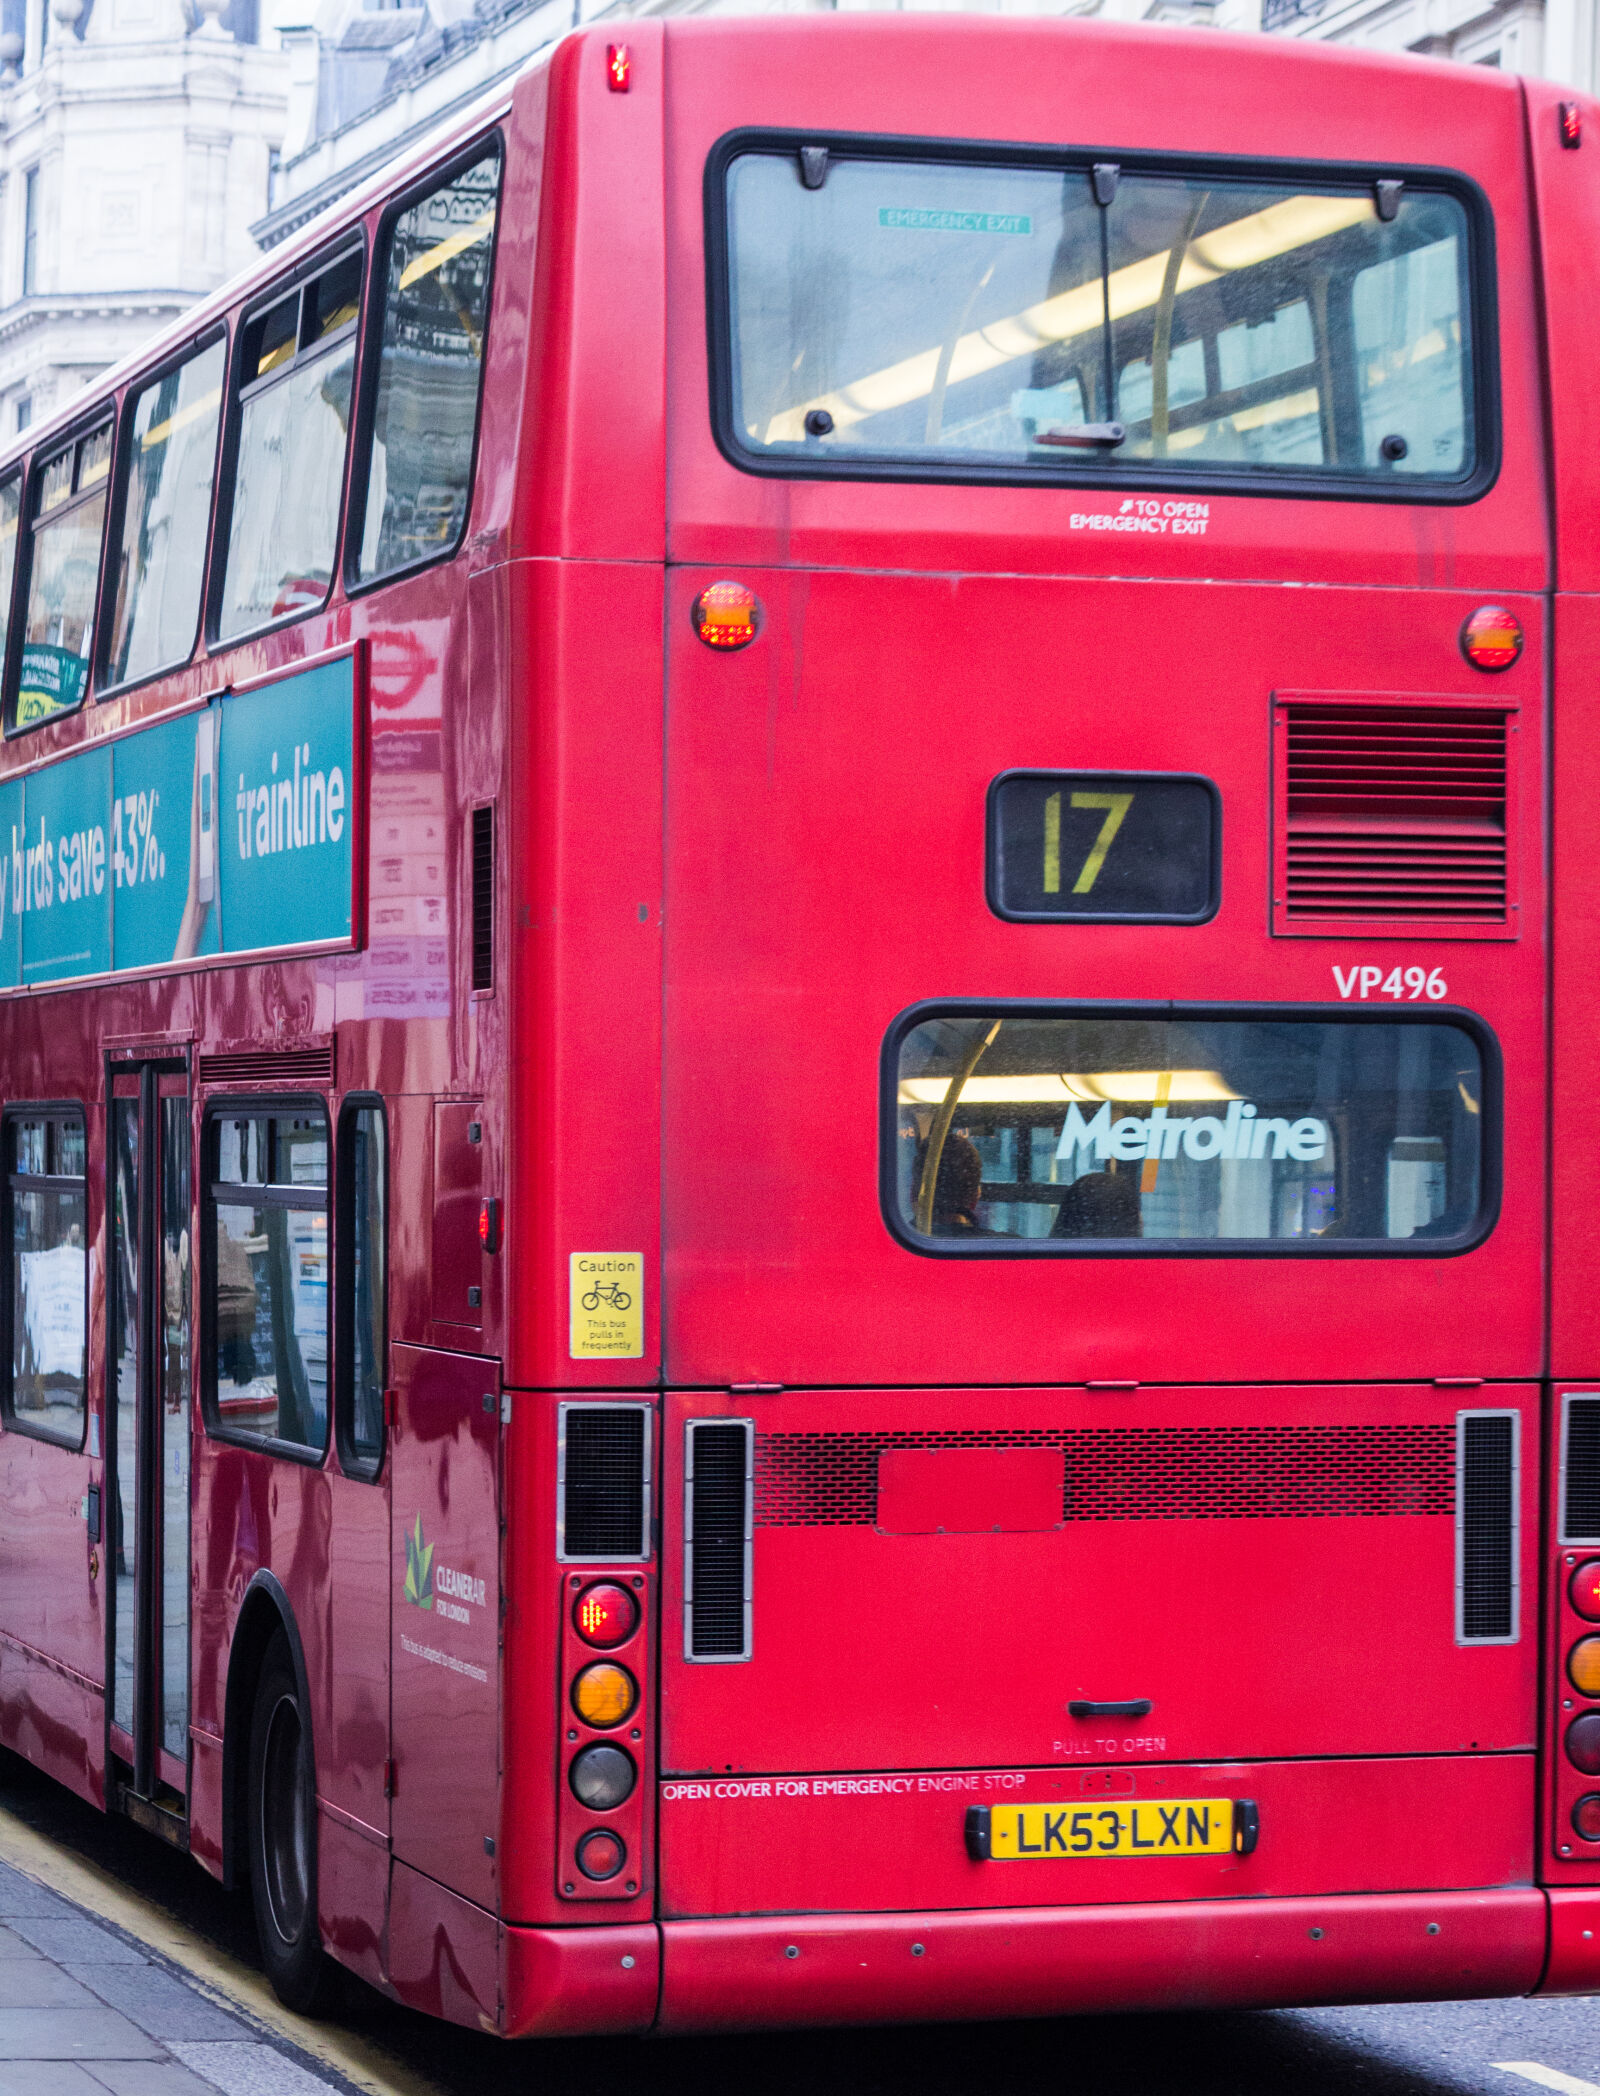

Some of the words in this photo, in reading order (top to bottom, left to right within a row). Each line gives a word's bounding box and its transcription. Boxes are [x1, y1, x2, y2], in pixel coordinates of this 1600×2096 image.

[887, 211, 983, 229] EMERGENCY
[987, 215, 1021, 232] EXIT
[1135, 500, 1160, 516] TO
[1163, 501, 1209, 518] OPEN
[1070, 513, 1169, 533] EMERGENCY
[1172, 518, 1209, 534] EXIT
[236, 742, 344, 860] trainline
[1043, 792, 1135, 894] 17
[58, 825, 105, 903] save
[1332, 965, 1448, 1000] VP496
[1055, 1100, 1325, 1161] Metroline
[578, 1260, 636, 1272] Caution
[587, 1319, 606, 1328] This
[610, 1319, 627, 1328] bus
[590, 1330, 613, 1339] pulls
[615, 1330, 624, 1338] in
[582, 1341, 632, 1350] frequently
[436, 1598, 447, 1617] FOR
[447, 1602, 470, 1625] LONDON
[1053, 1740, 1091, 1755] PULL
[1095, 1738, 1118, 1753] TO
[1124, 1737, 1166, 1752] OPEN
[662, 1784, 711, 1800] OPEN
[714, 1782, 771, 1798] COVER
[775, 1781, 810, 1797] FOR
[813, 1778, 913, 1796] EMERGENCY
[918, 1776, 979, 1793] ENGINE
[983, 1774, 1026, 1790] STOP
[1017, 1811, 1120, 1853] LK53
[1131, 1806, 1210, 1848] LXN
